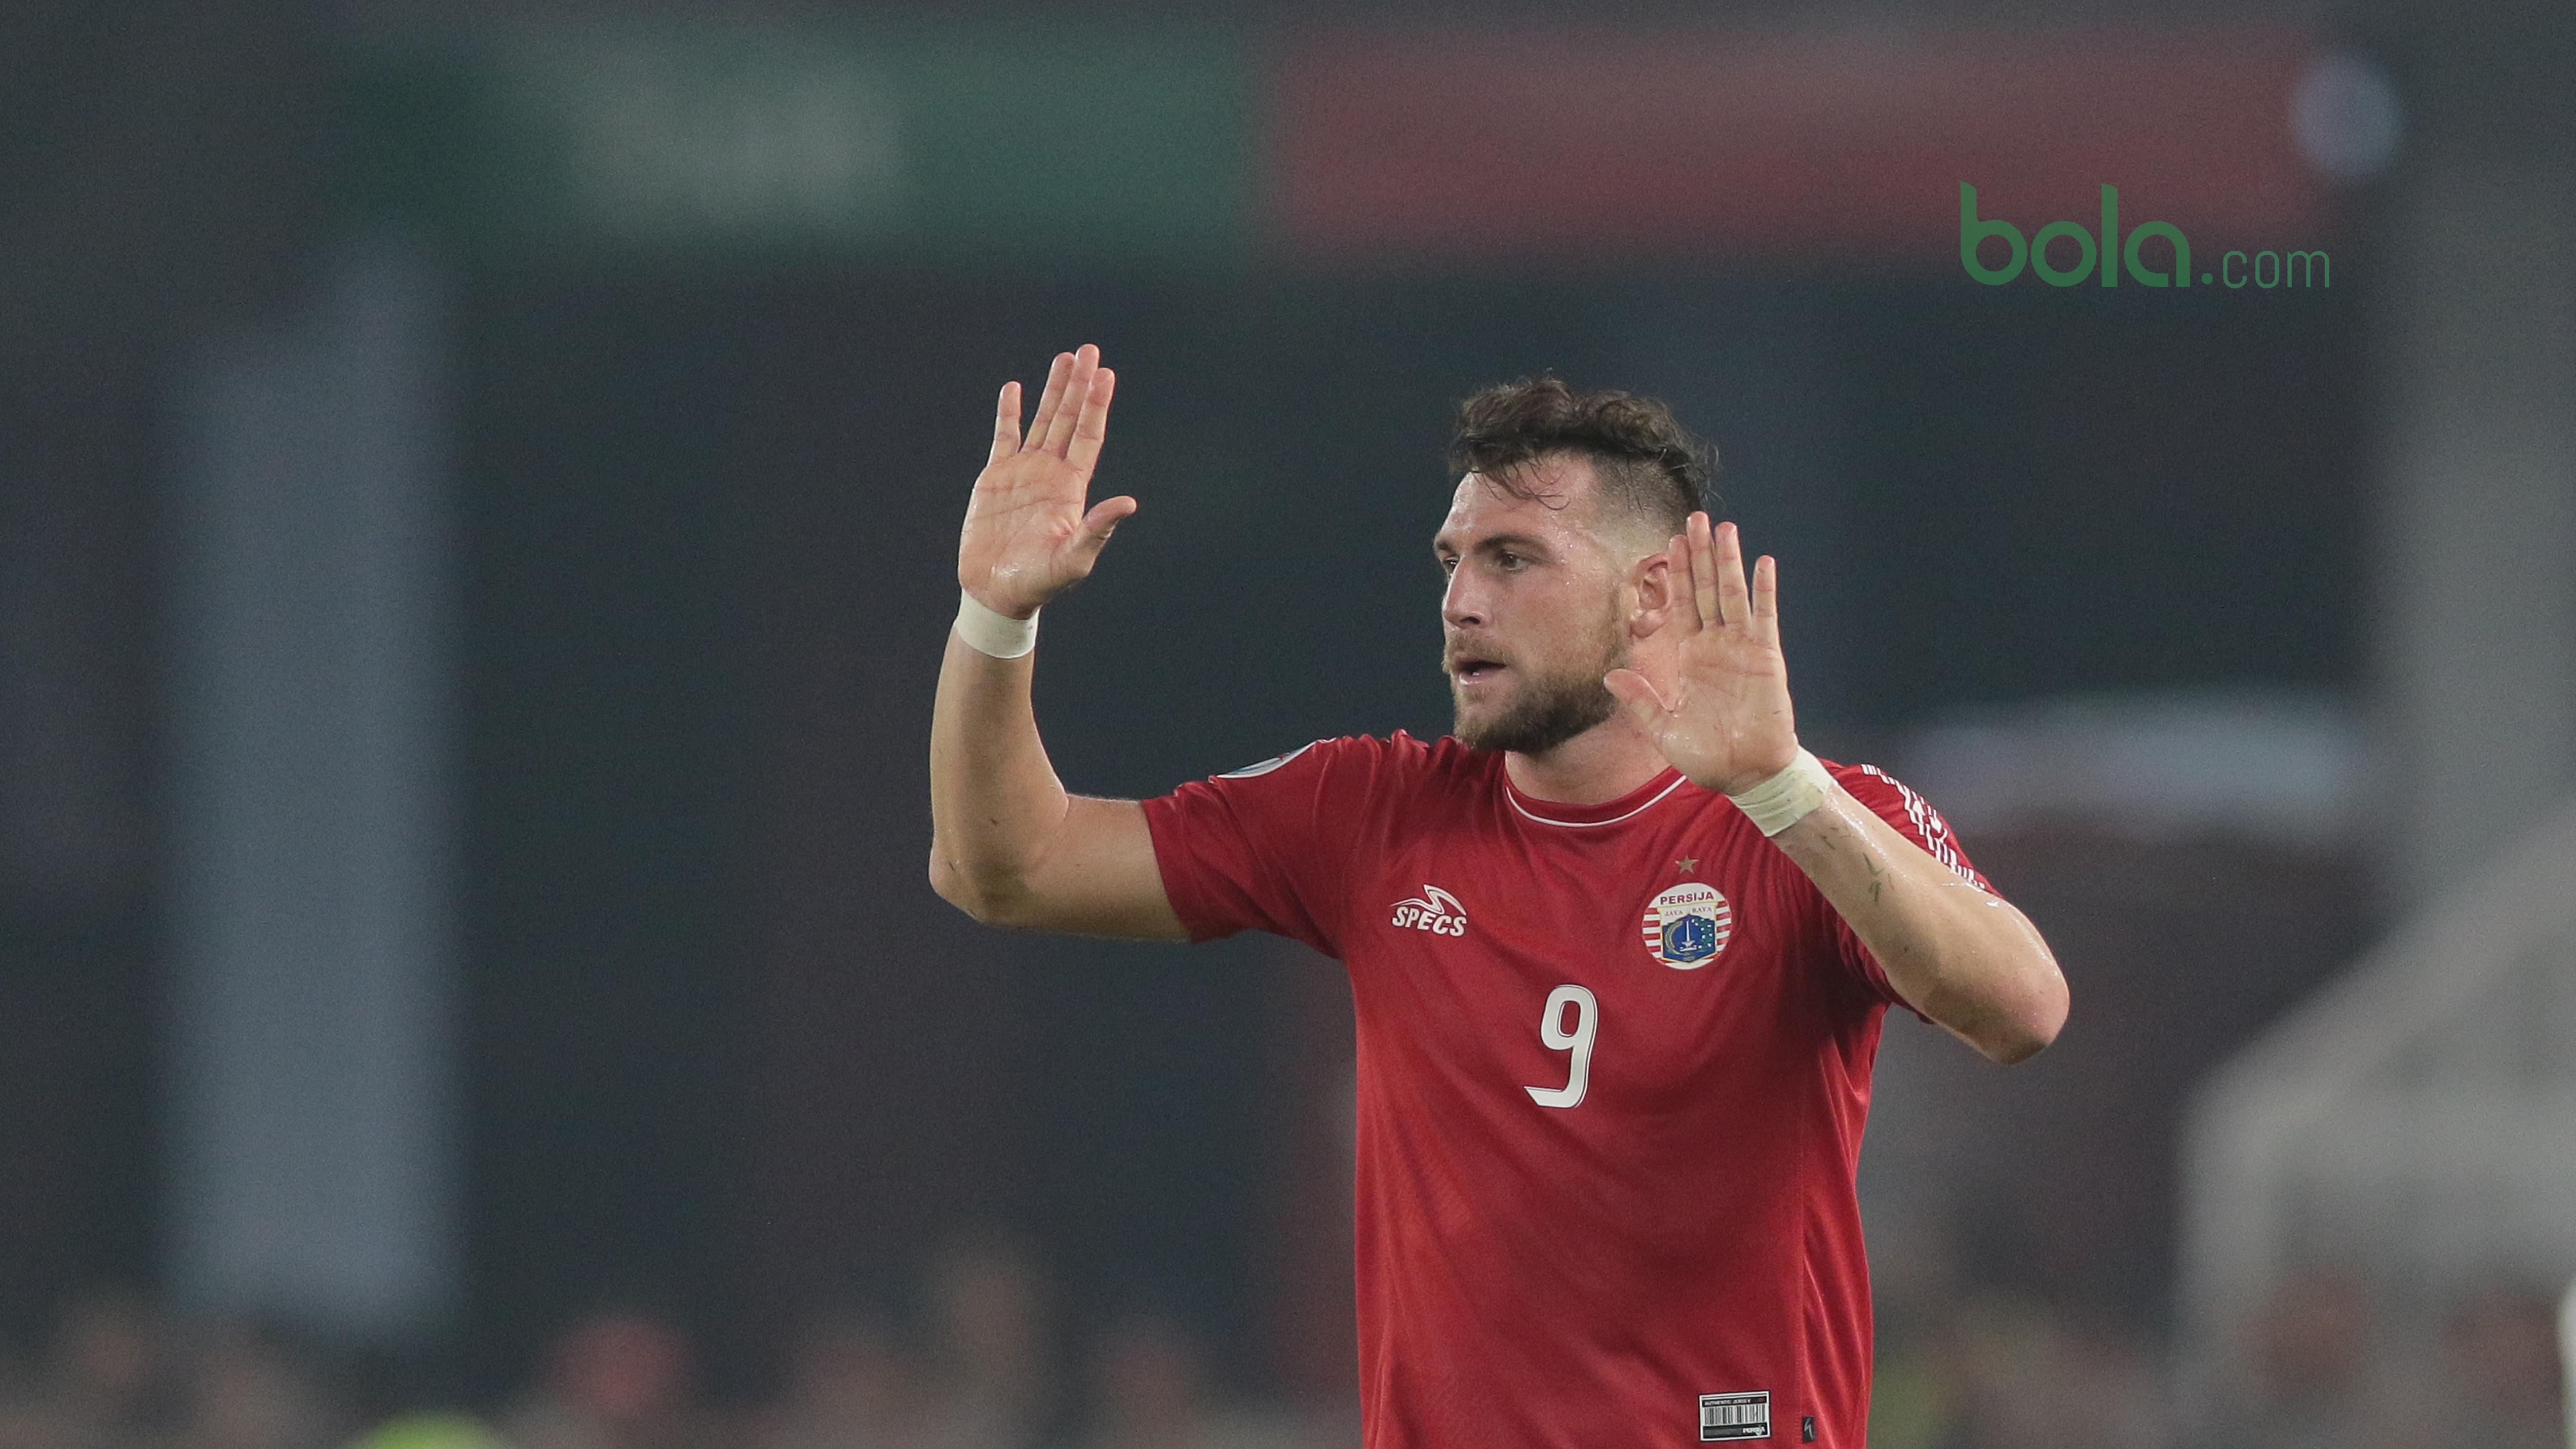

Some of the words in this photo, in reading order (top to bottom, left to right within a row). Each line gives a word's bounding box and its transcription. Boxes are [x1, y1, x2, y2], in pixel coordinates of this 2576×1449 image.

[1660, 891, 1714, 905] PERSIJA
[1392, 906, 1467, 937] SPECS
[1524, 984, 1598, 1109] 9
